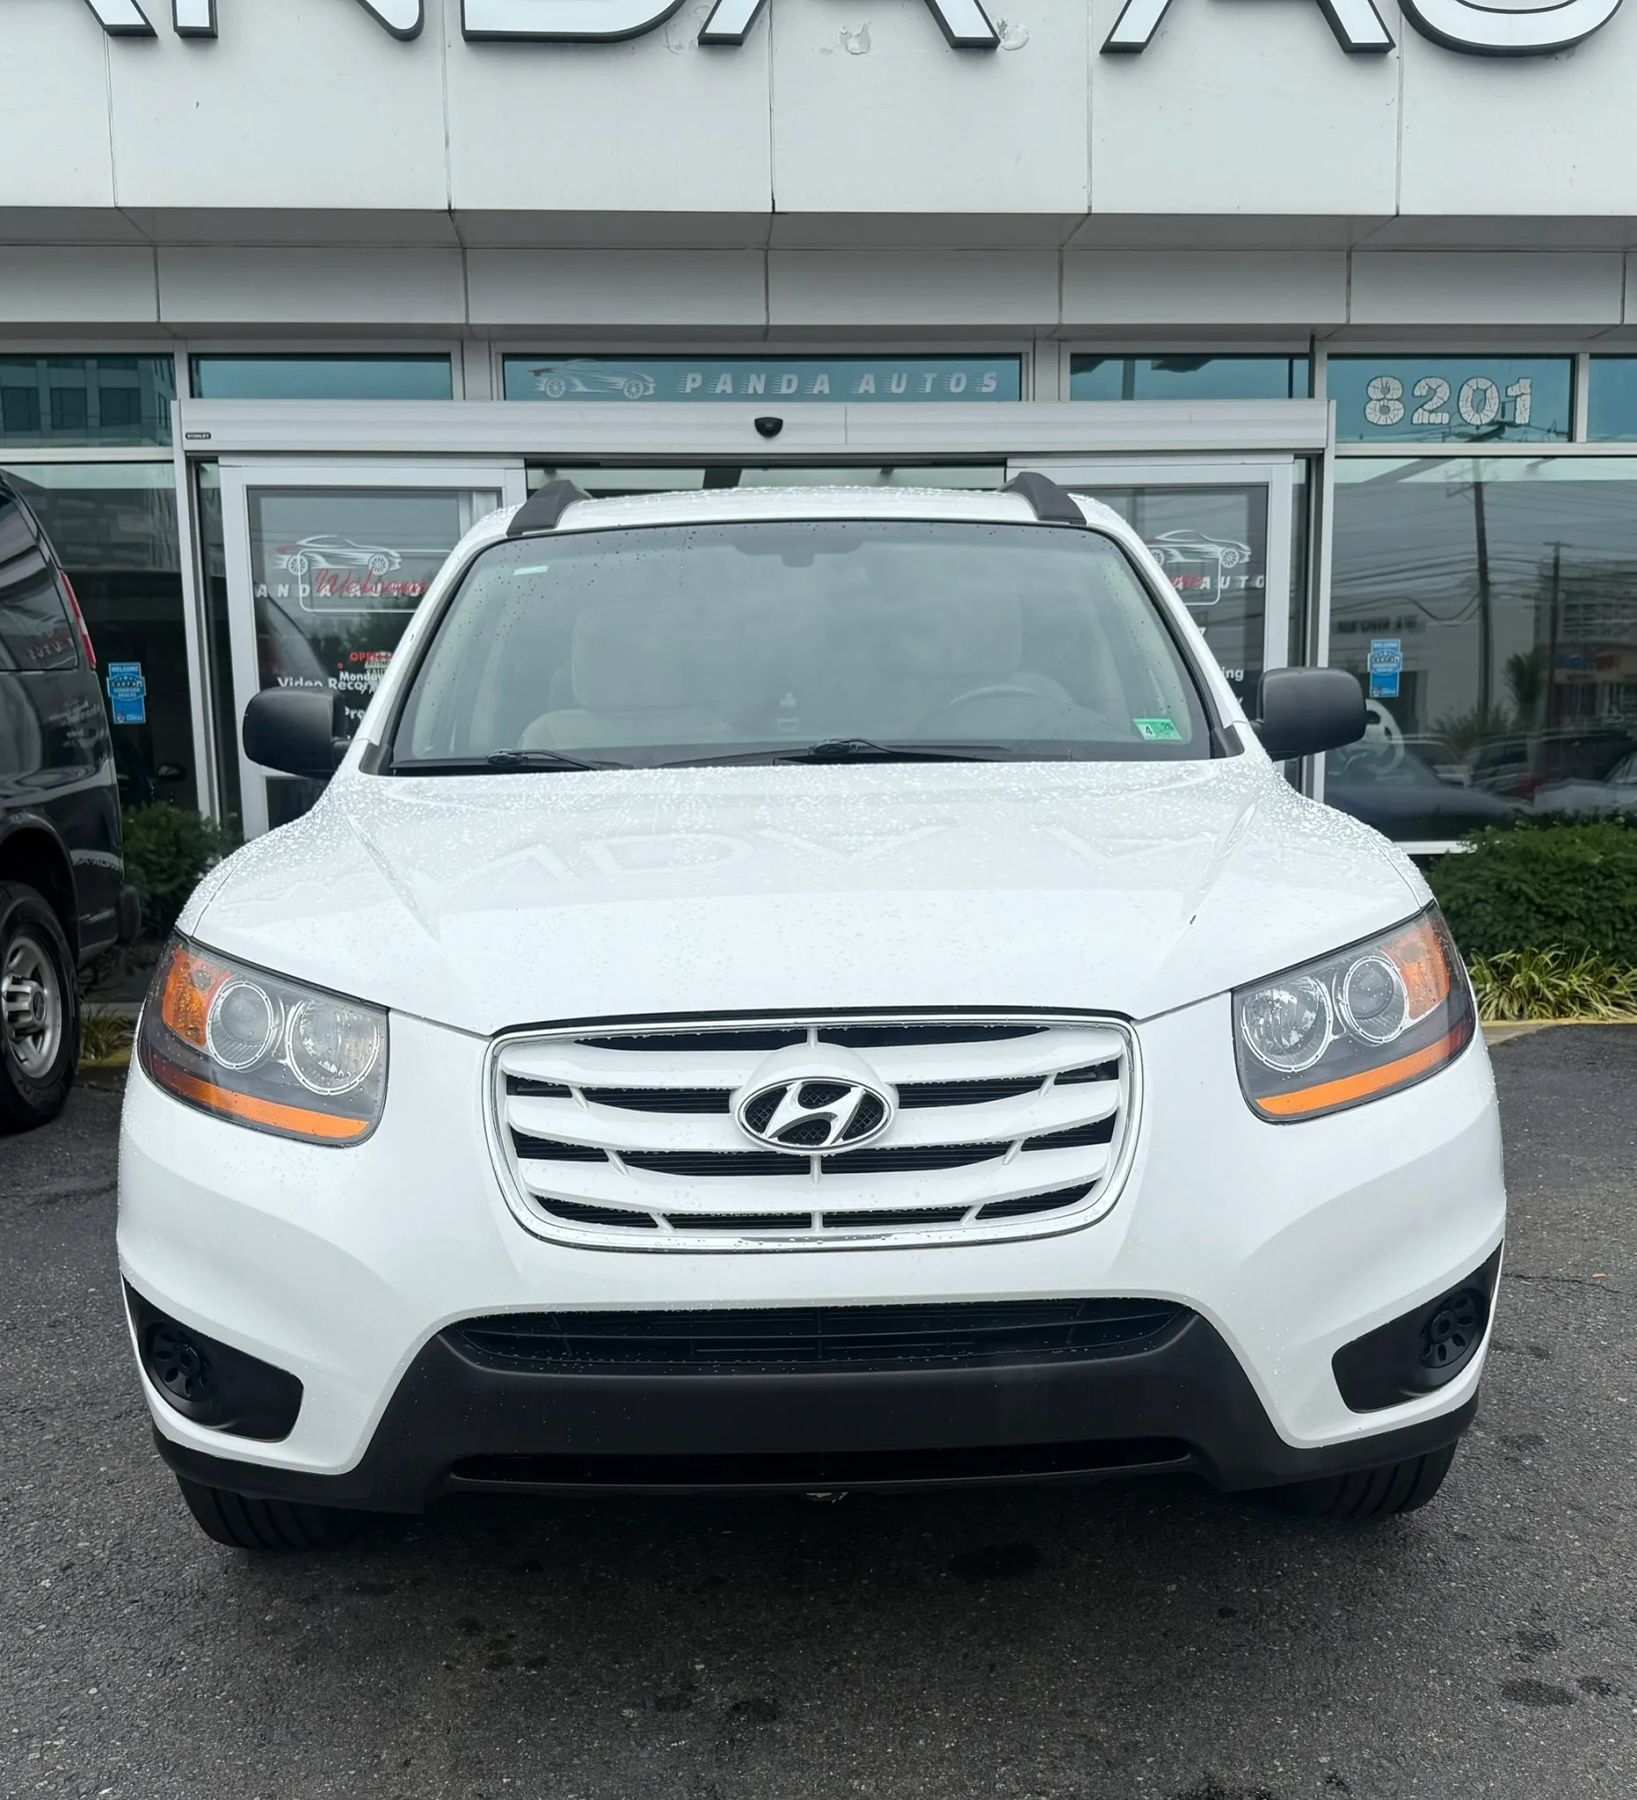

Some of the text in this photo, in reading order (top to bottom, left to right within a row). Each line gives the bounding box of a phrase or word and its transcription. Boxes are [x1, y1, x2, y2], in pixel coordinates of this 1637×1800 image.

[682, 371, 998, 395] PANDA AUTOS
[1364, 375, 1532, 427] 8201
